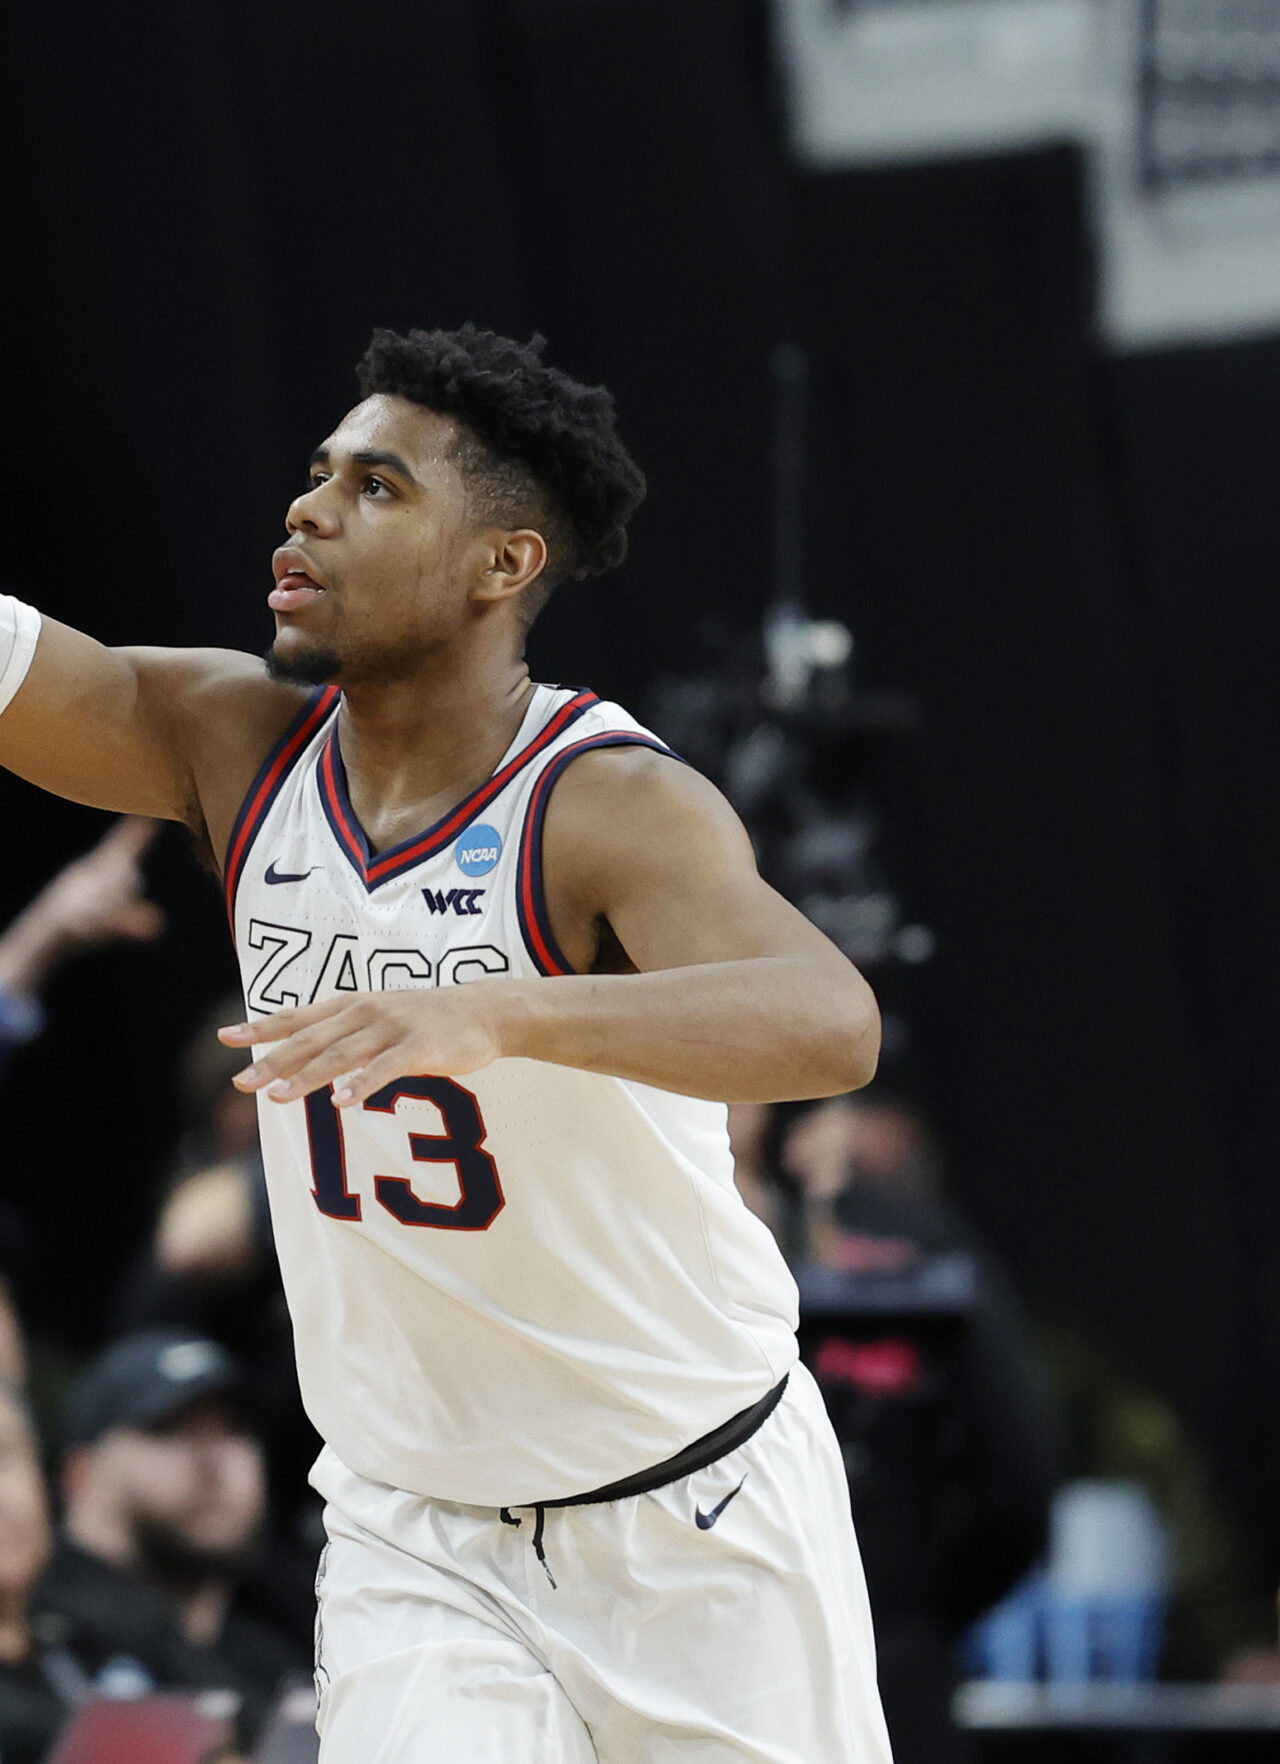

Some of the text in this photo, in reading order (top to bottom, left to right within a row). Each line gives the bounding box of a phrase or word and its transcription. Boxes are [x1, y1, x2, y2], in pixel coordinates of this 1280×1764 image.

[460, 847, 498, 865] NCAA
[421, 888, 486, 916] WCC
[304, 1074, 506, 1231] 13
